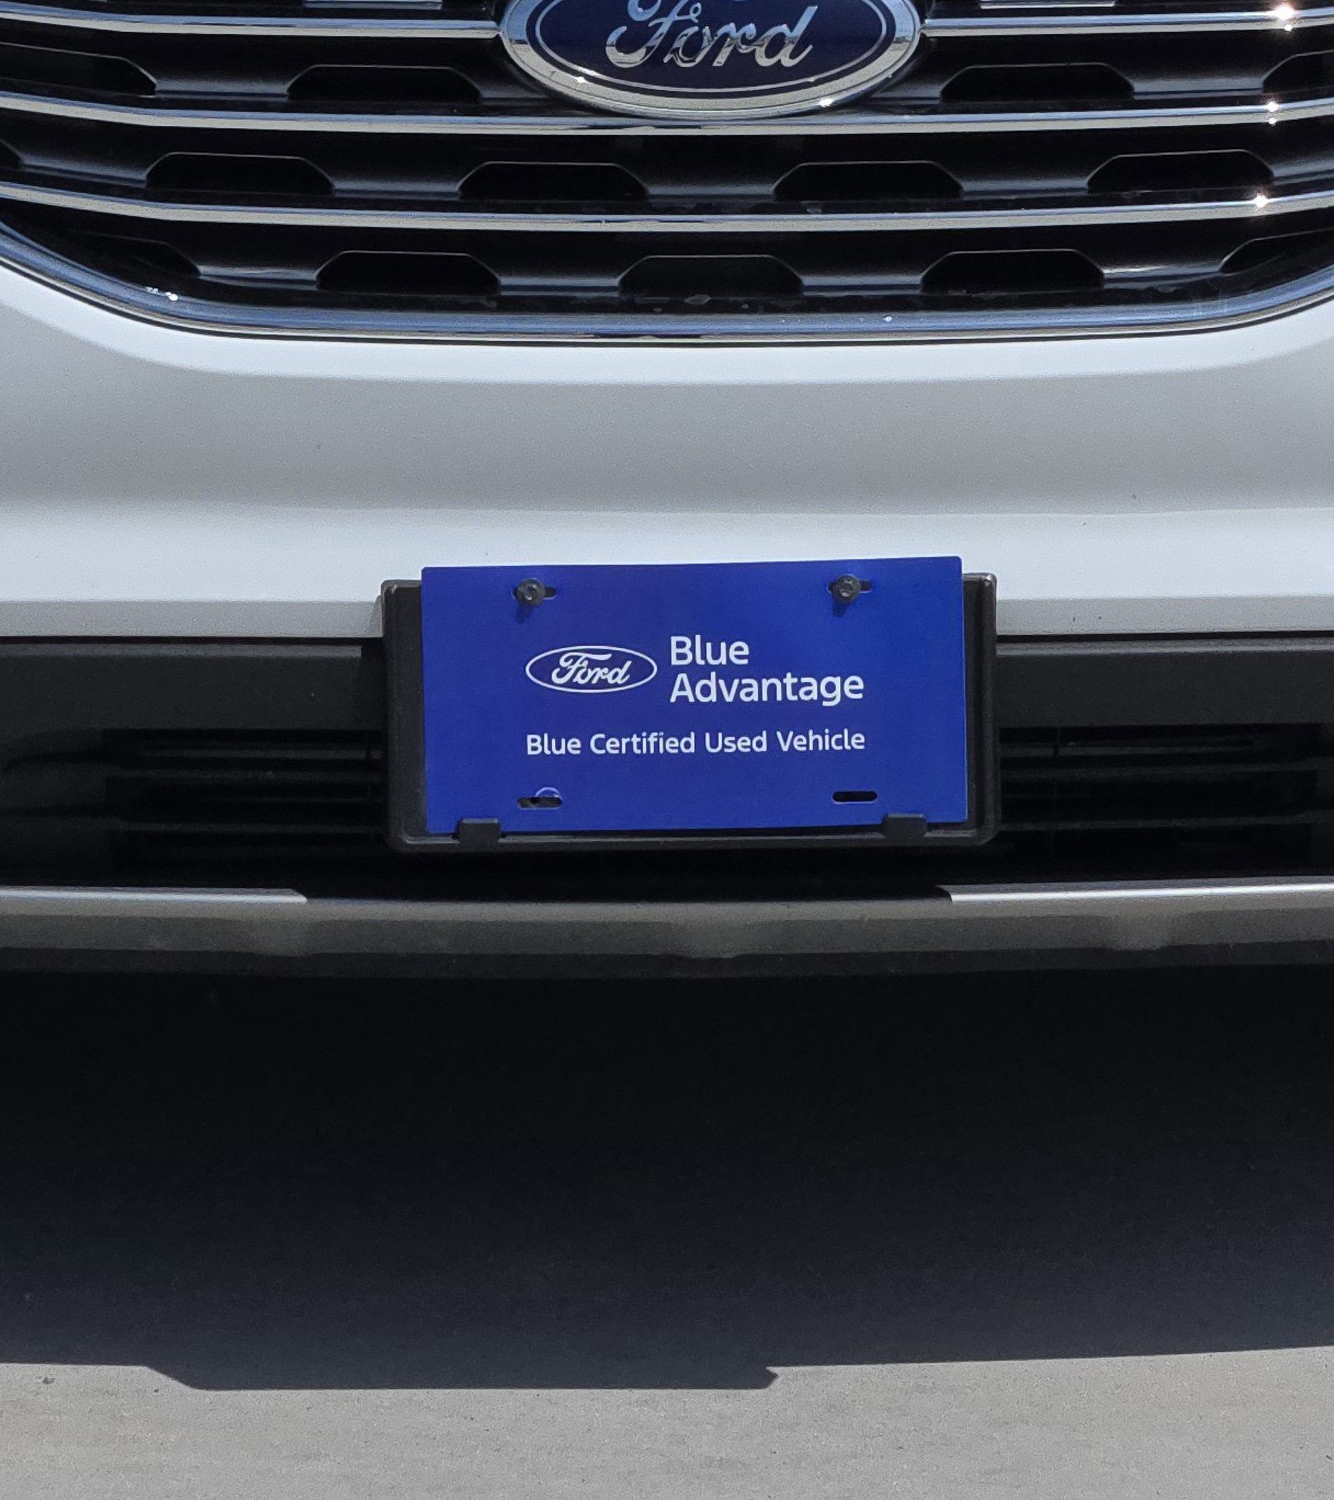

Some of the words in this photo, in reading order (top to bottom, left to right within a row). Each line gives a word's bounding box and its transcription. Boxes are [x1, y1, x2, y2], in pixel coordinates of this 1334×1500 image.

[670, 634, 750, 666] Blue
[551, 651, 632, 685] Ford
[669, 670, 865, 707] Advantage
[526, 733, 581, 755] Blue
[589, 731, 695, 755] Certified
[704, 730, 767, 753] Used
[776, 728, 865, 752] Vehicle
